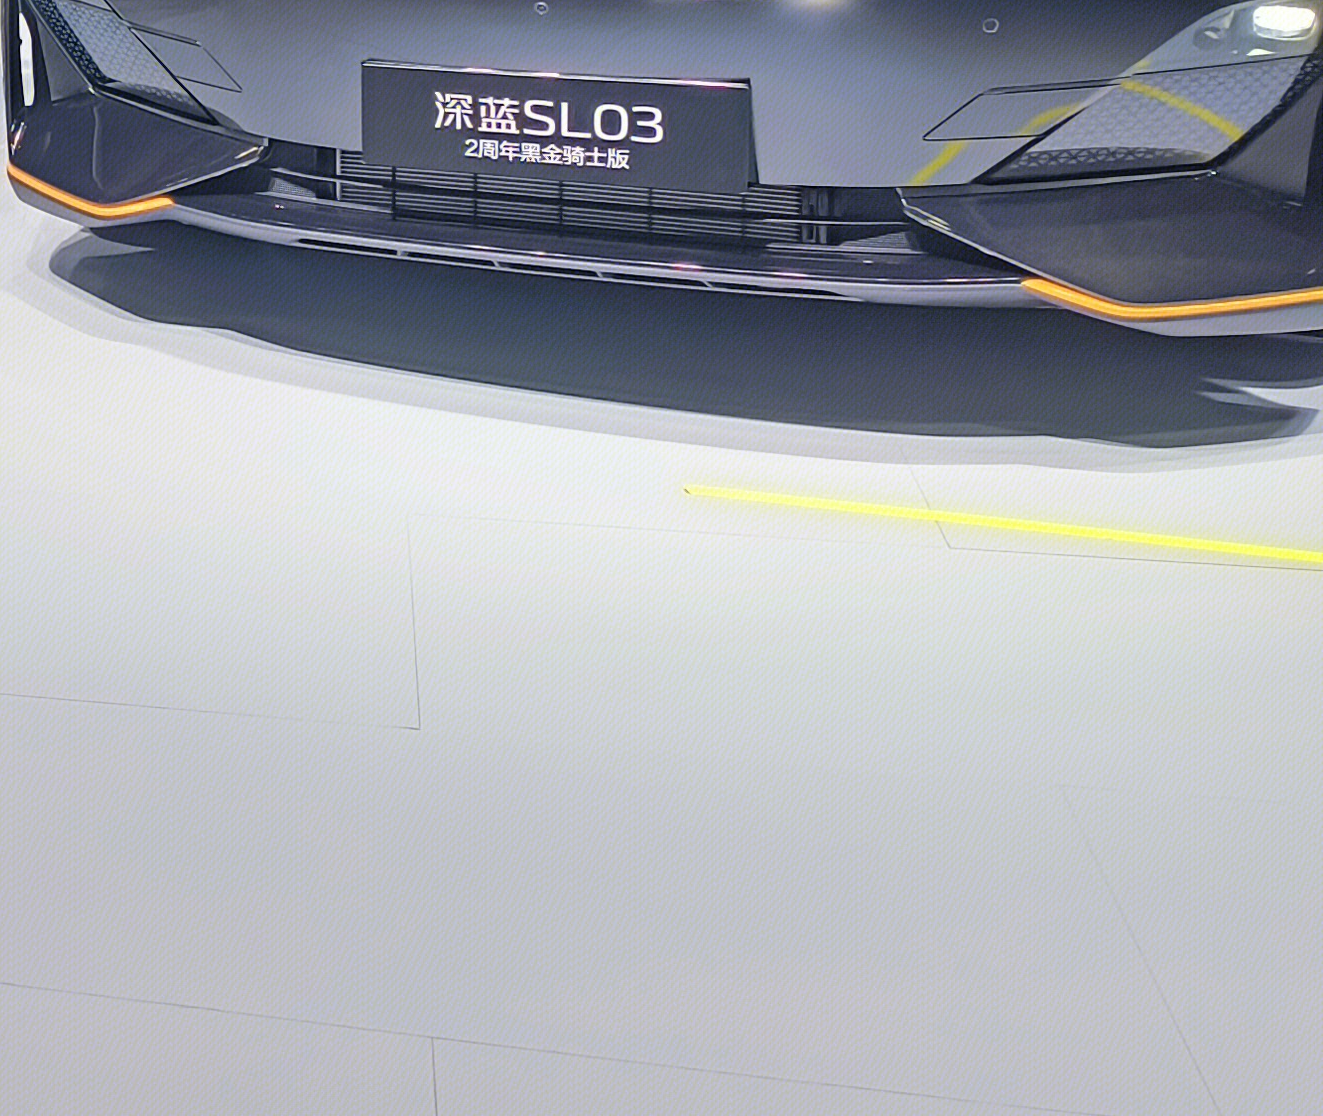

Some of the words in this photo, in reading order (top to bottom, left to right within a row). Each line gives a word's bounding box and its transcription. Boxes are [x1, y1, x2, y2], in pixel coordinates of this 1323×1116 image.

[434, 91, 664, 144] 深蓝SL03
[464, 138, 630, 170] 2周年黑金骑士版
